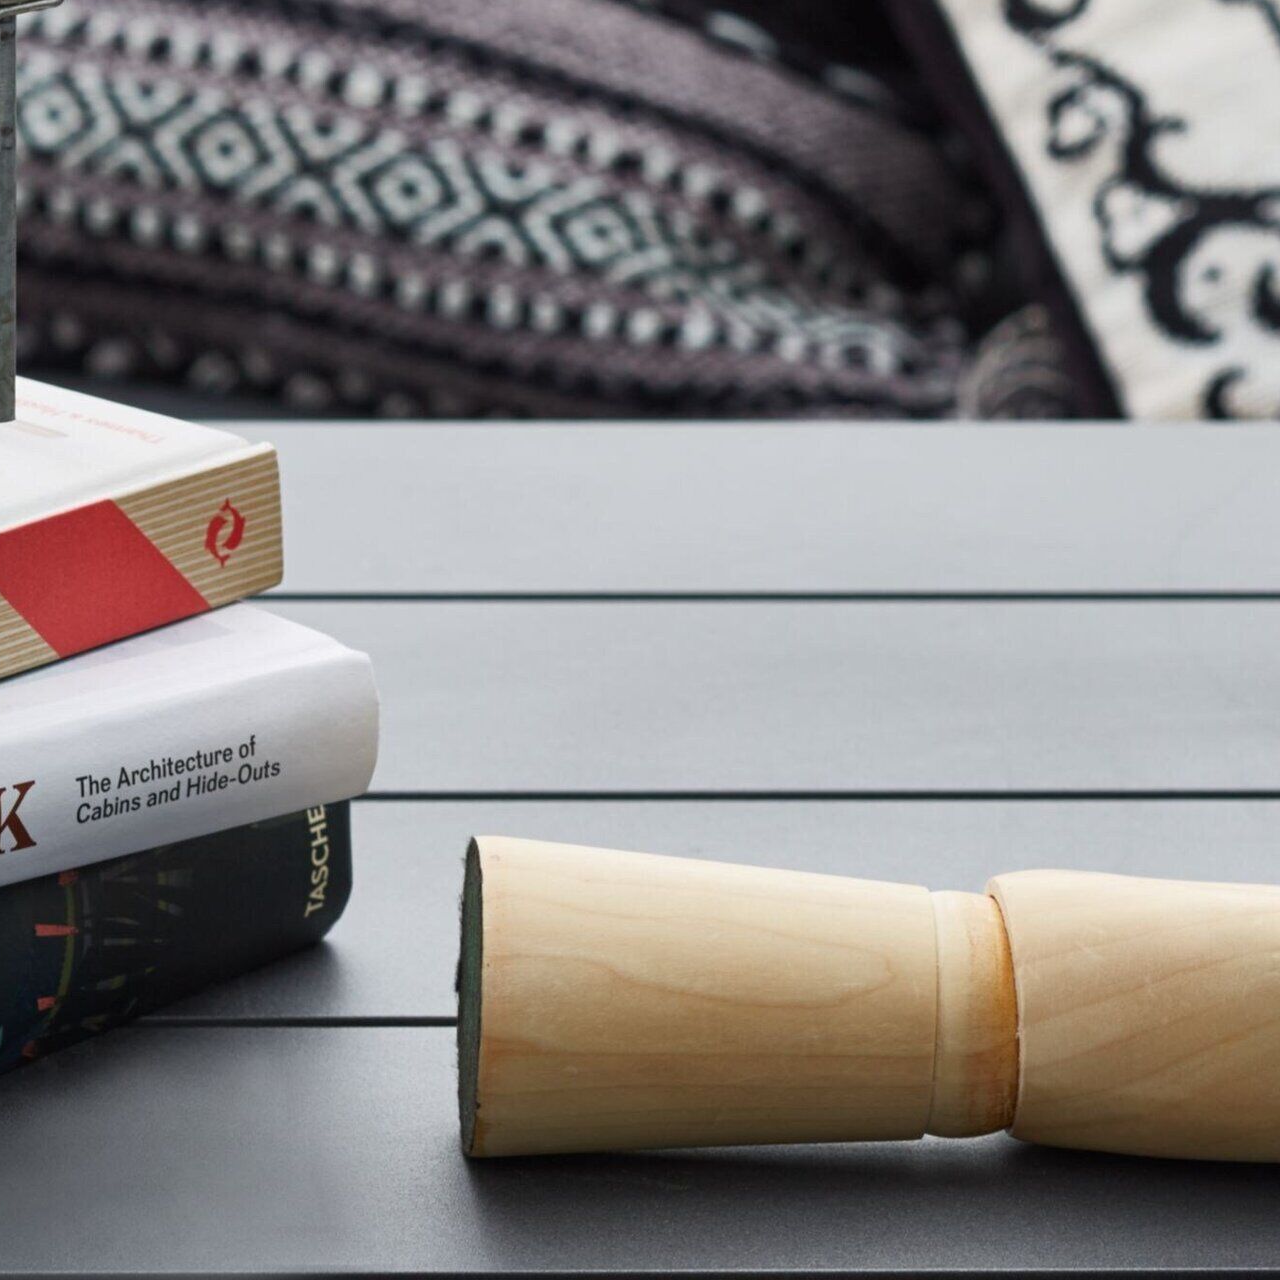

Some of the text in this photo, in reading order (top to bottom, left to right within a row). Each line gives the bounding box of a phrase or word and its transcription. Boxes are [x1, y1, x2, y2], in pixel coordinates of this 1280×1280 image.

[76, 735, 256, 797] The Architecture of
[76, 762, 280, 824] Cabins and Hide-Outs
